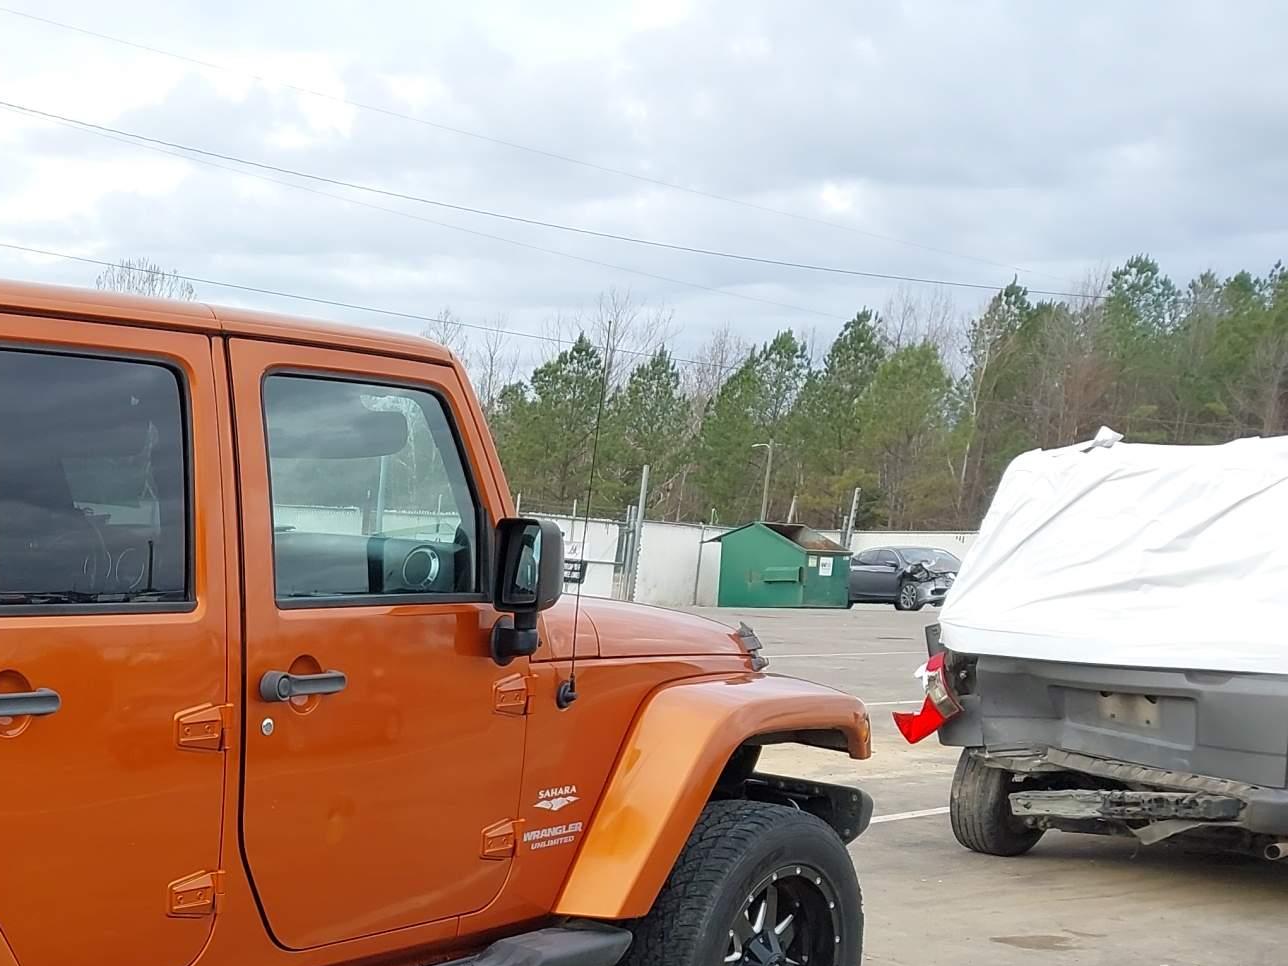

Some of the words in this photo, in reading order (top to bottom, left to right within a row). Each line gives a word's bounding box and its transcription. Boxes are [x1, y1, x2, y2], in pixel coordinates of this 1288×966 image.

[539, 785, 577, 799] SAHARA
[523, 822, 583, 842] WRANGLER
[531, 836, 574, 849] UNLIMITED
